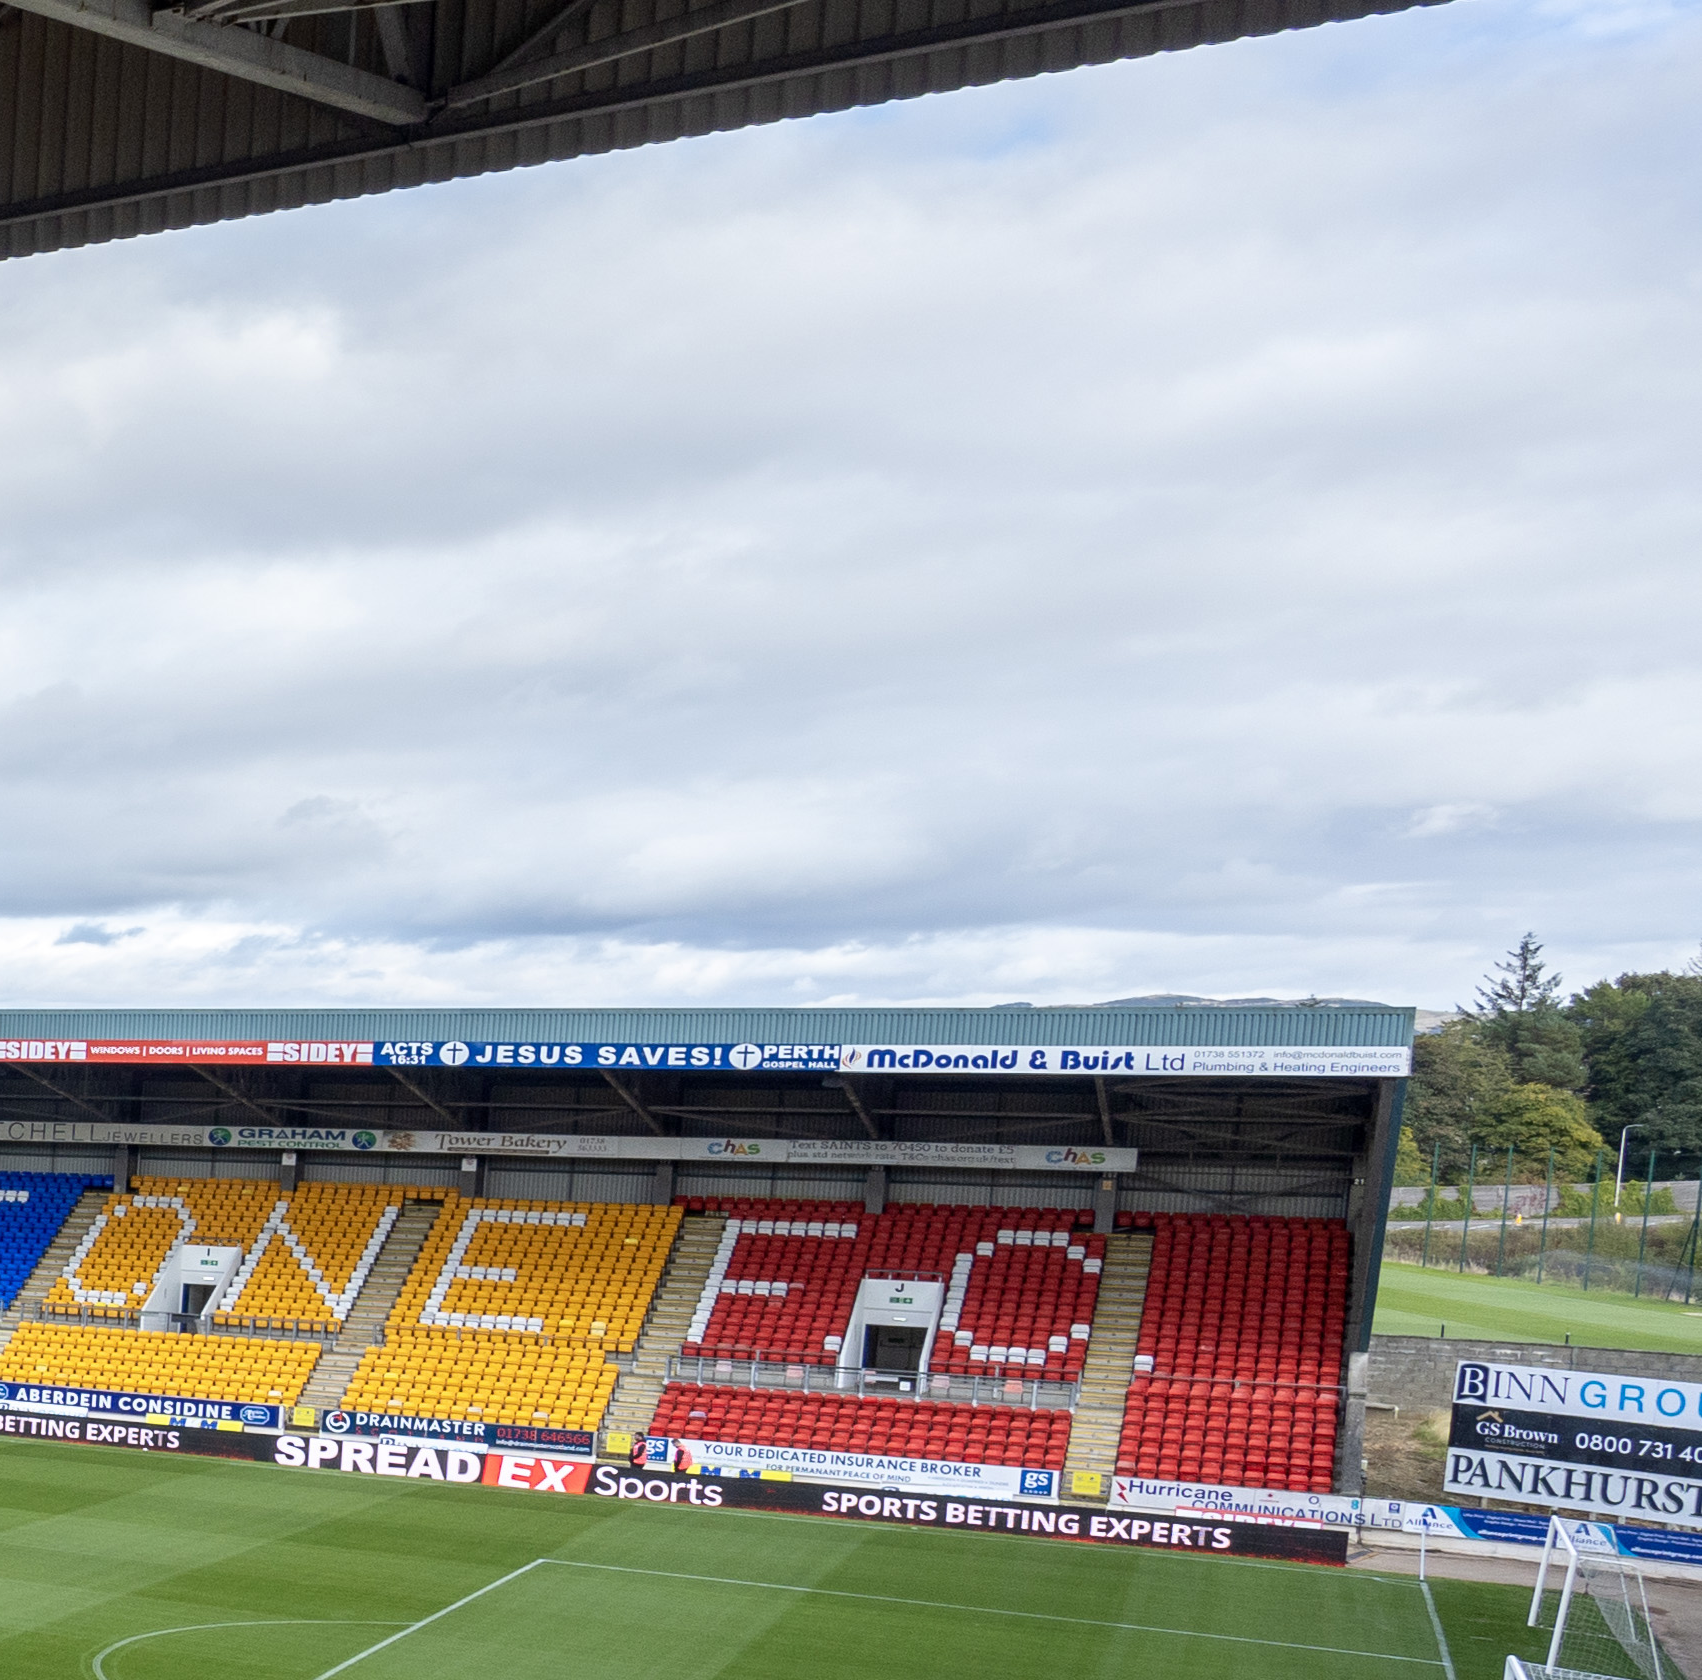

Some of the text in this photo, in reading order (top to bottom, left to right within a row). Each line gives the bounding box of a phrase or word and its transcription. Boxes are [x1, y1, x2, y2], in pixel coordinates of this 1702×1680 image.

[6, 1041, 263, 1060] SIDEY WINDOWS DOORS LIVING SPACES
[283, 1042, 357, 1062] SIDEY
[380, 1042, 433, 1056] ACTS
[475, 1045, 722, 1066] JESUS SAVES!
[762, 1045, 840, 1059] PERTH
[762, 1060, 837, 1069] GOSPEL HALL
[866, 1049, 1185, 1071] McDonald & Buist Ltd
[1192, 1061, 1401, 1075] Plumbing & Heating Engineers
[103, 1131, 203, 1145] JEWELLERS
[237, 1139, 344, 1149] PEST CONTROL
[238, 1128, 346, 1141] GRAHAM
[434, 1133, 568, 1151] Tower Bakery
[895, 1282, 904, 1293] J
[1459, 1363, 1702, 1420] BINN GRO
[15, 1387, 112, 1410] ABERDEIN
[118, 1395, 233, 1420] CONSIDINE
[355, 1413, 486, 1437] DRAINMASTER
[1475, 1420, 1560, 1445] GS Brown
[85, 1422, 180, 1449] EXPERTS
[1484, 1437, 1546, 1450] CONSTRUCTION
[1575, 1432, 1632, 1454] 0800
[1638, 1439, 1674, 1459] 731
[703, 1442, 982, 1479] YOUR DEDICATED INSURANCE BROKER
[765, 1463, 912, 1483] FOR PERMANANT PEACE OF MIND
[1023, 1471, 1049, 1489] gs
[594, 1465, 723, 1507] Sports
[1128, 1478, 1234, 1503] Hurricane
[1448, 1453, 1702, 1518] PANKHURST
[822, 1490, 1232, 1550] SPORTS BETTING EXPERTS
[1191, 1499, 1366, 1526] COMMUNICATIONS
